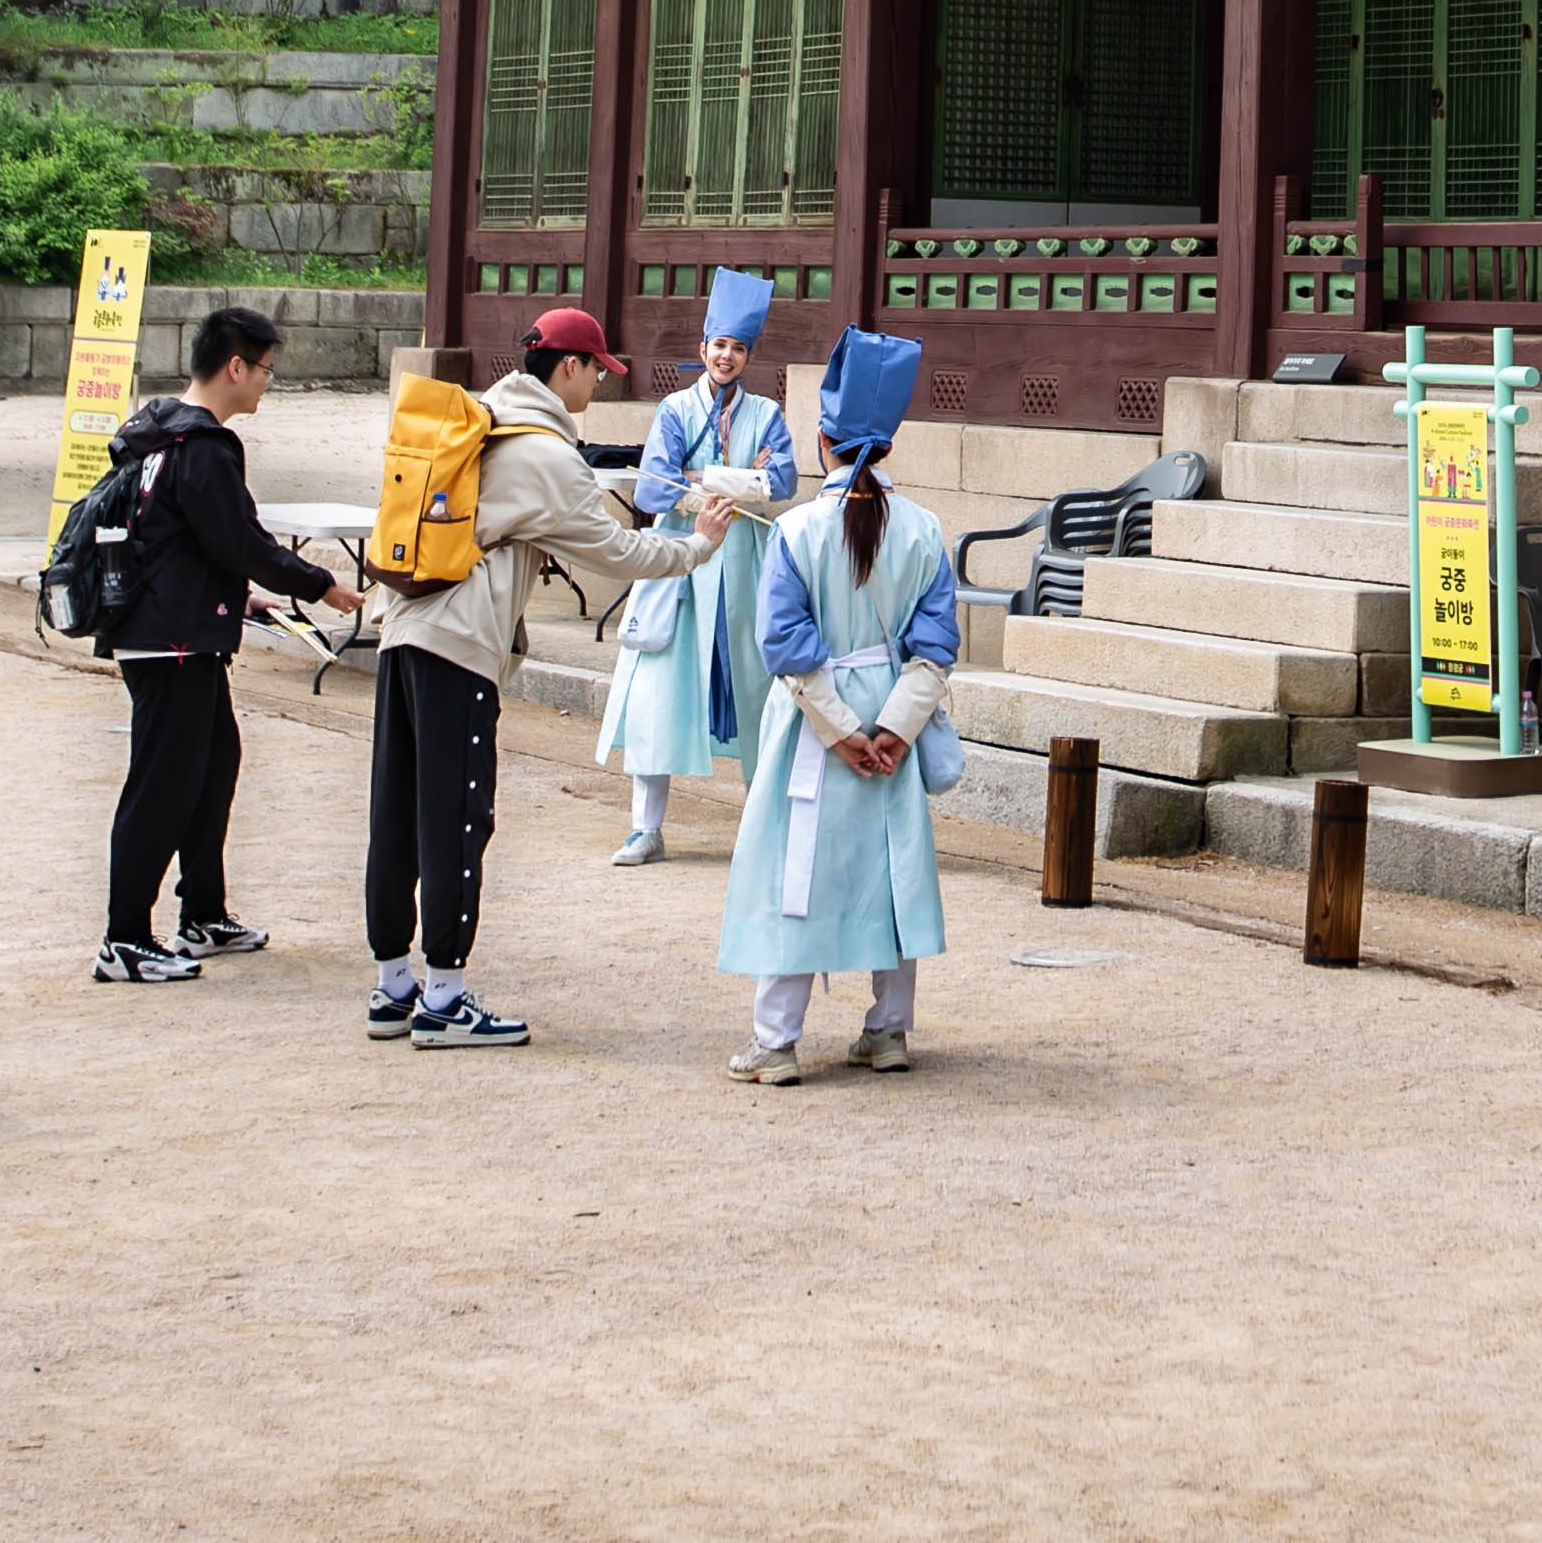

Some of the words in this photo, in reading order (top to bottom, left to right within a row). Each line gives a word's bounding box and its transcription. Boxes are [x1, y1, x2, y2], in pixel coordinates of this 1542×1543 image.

[75, 379, 122, 401] 궁중놀이방
[1439, 566, 1467, 593] 궁중
[1434, 597, 1474, 626] 놀이방
[1432, 637, 1452, 648] 10:00
[1459, 640, 1479, 651] 17:00
